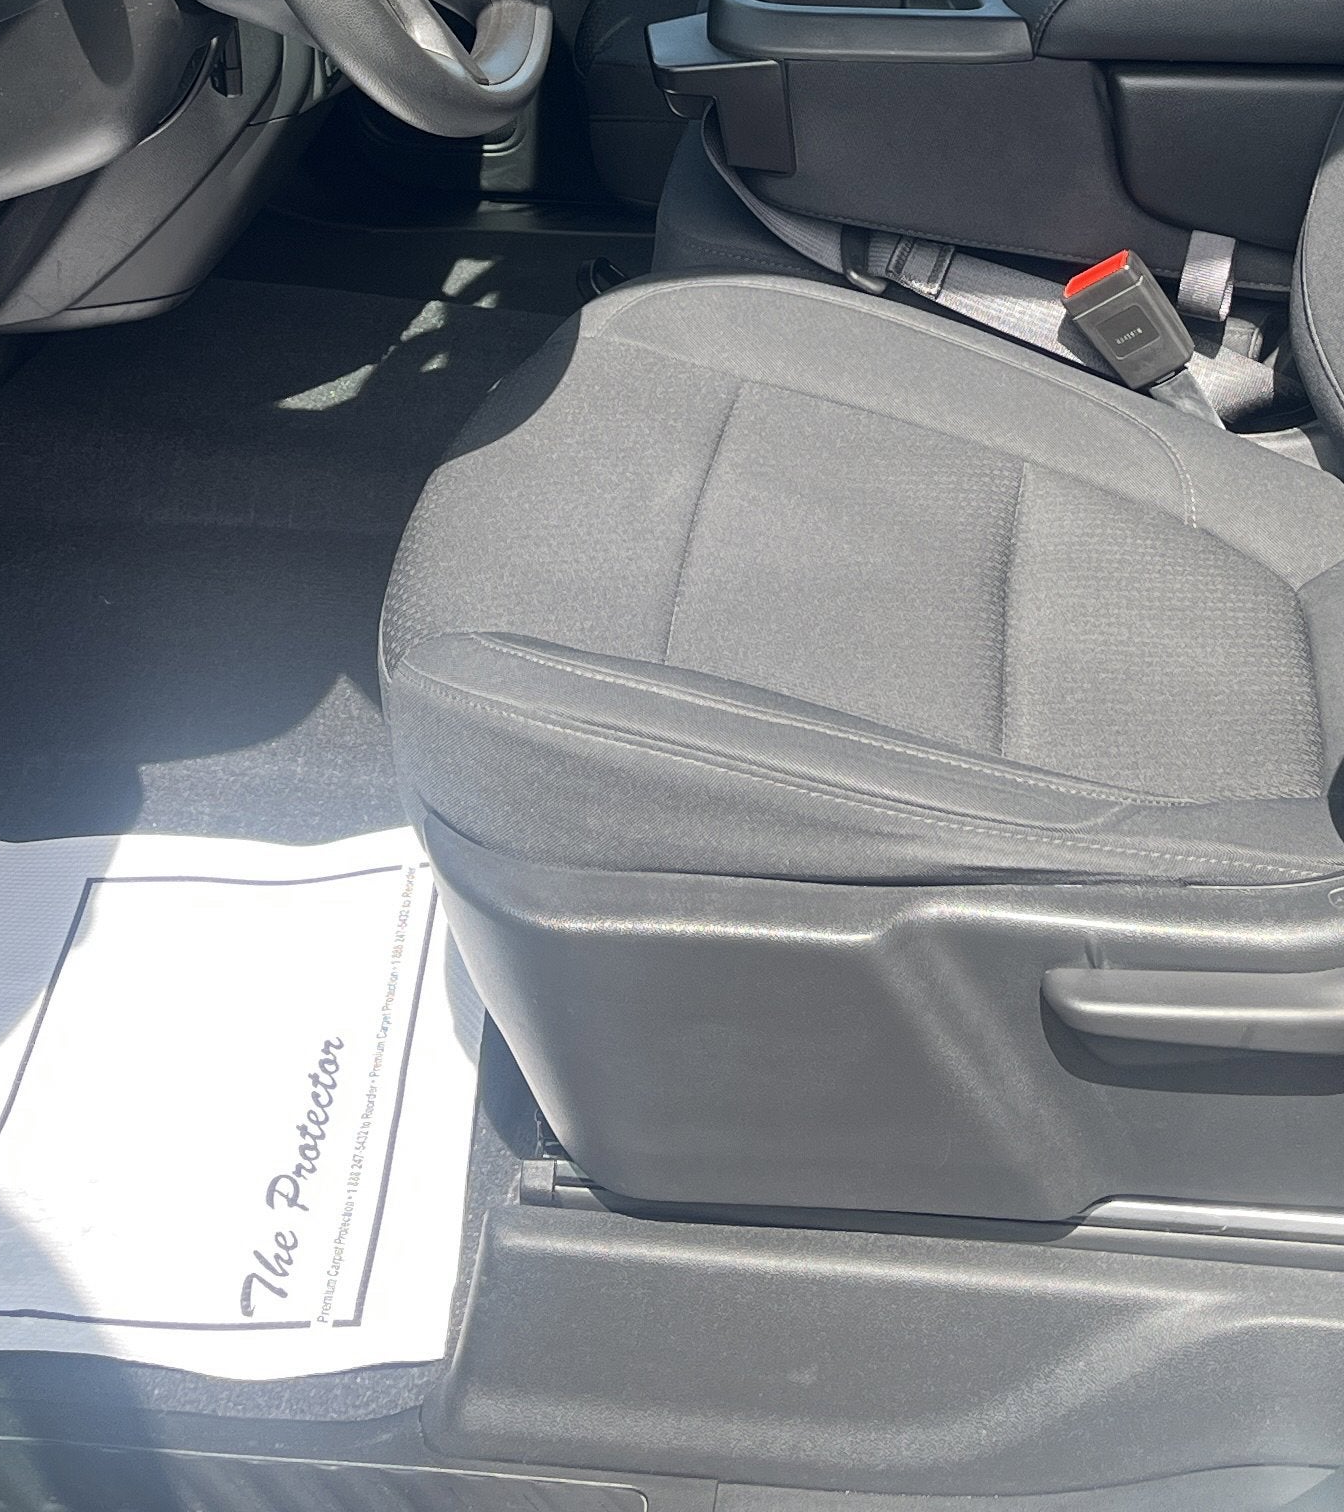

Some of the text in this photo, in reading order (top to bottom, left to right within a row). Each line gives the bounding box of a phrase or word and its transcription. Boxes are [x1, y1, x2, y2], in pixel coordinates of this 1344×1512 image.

[240, 1036, 345, 1317] The Protector
[316, 1278, 338, 1324] Premium
